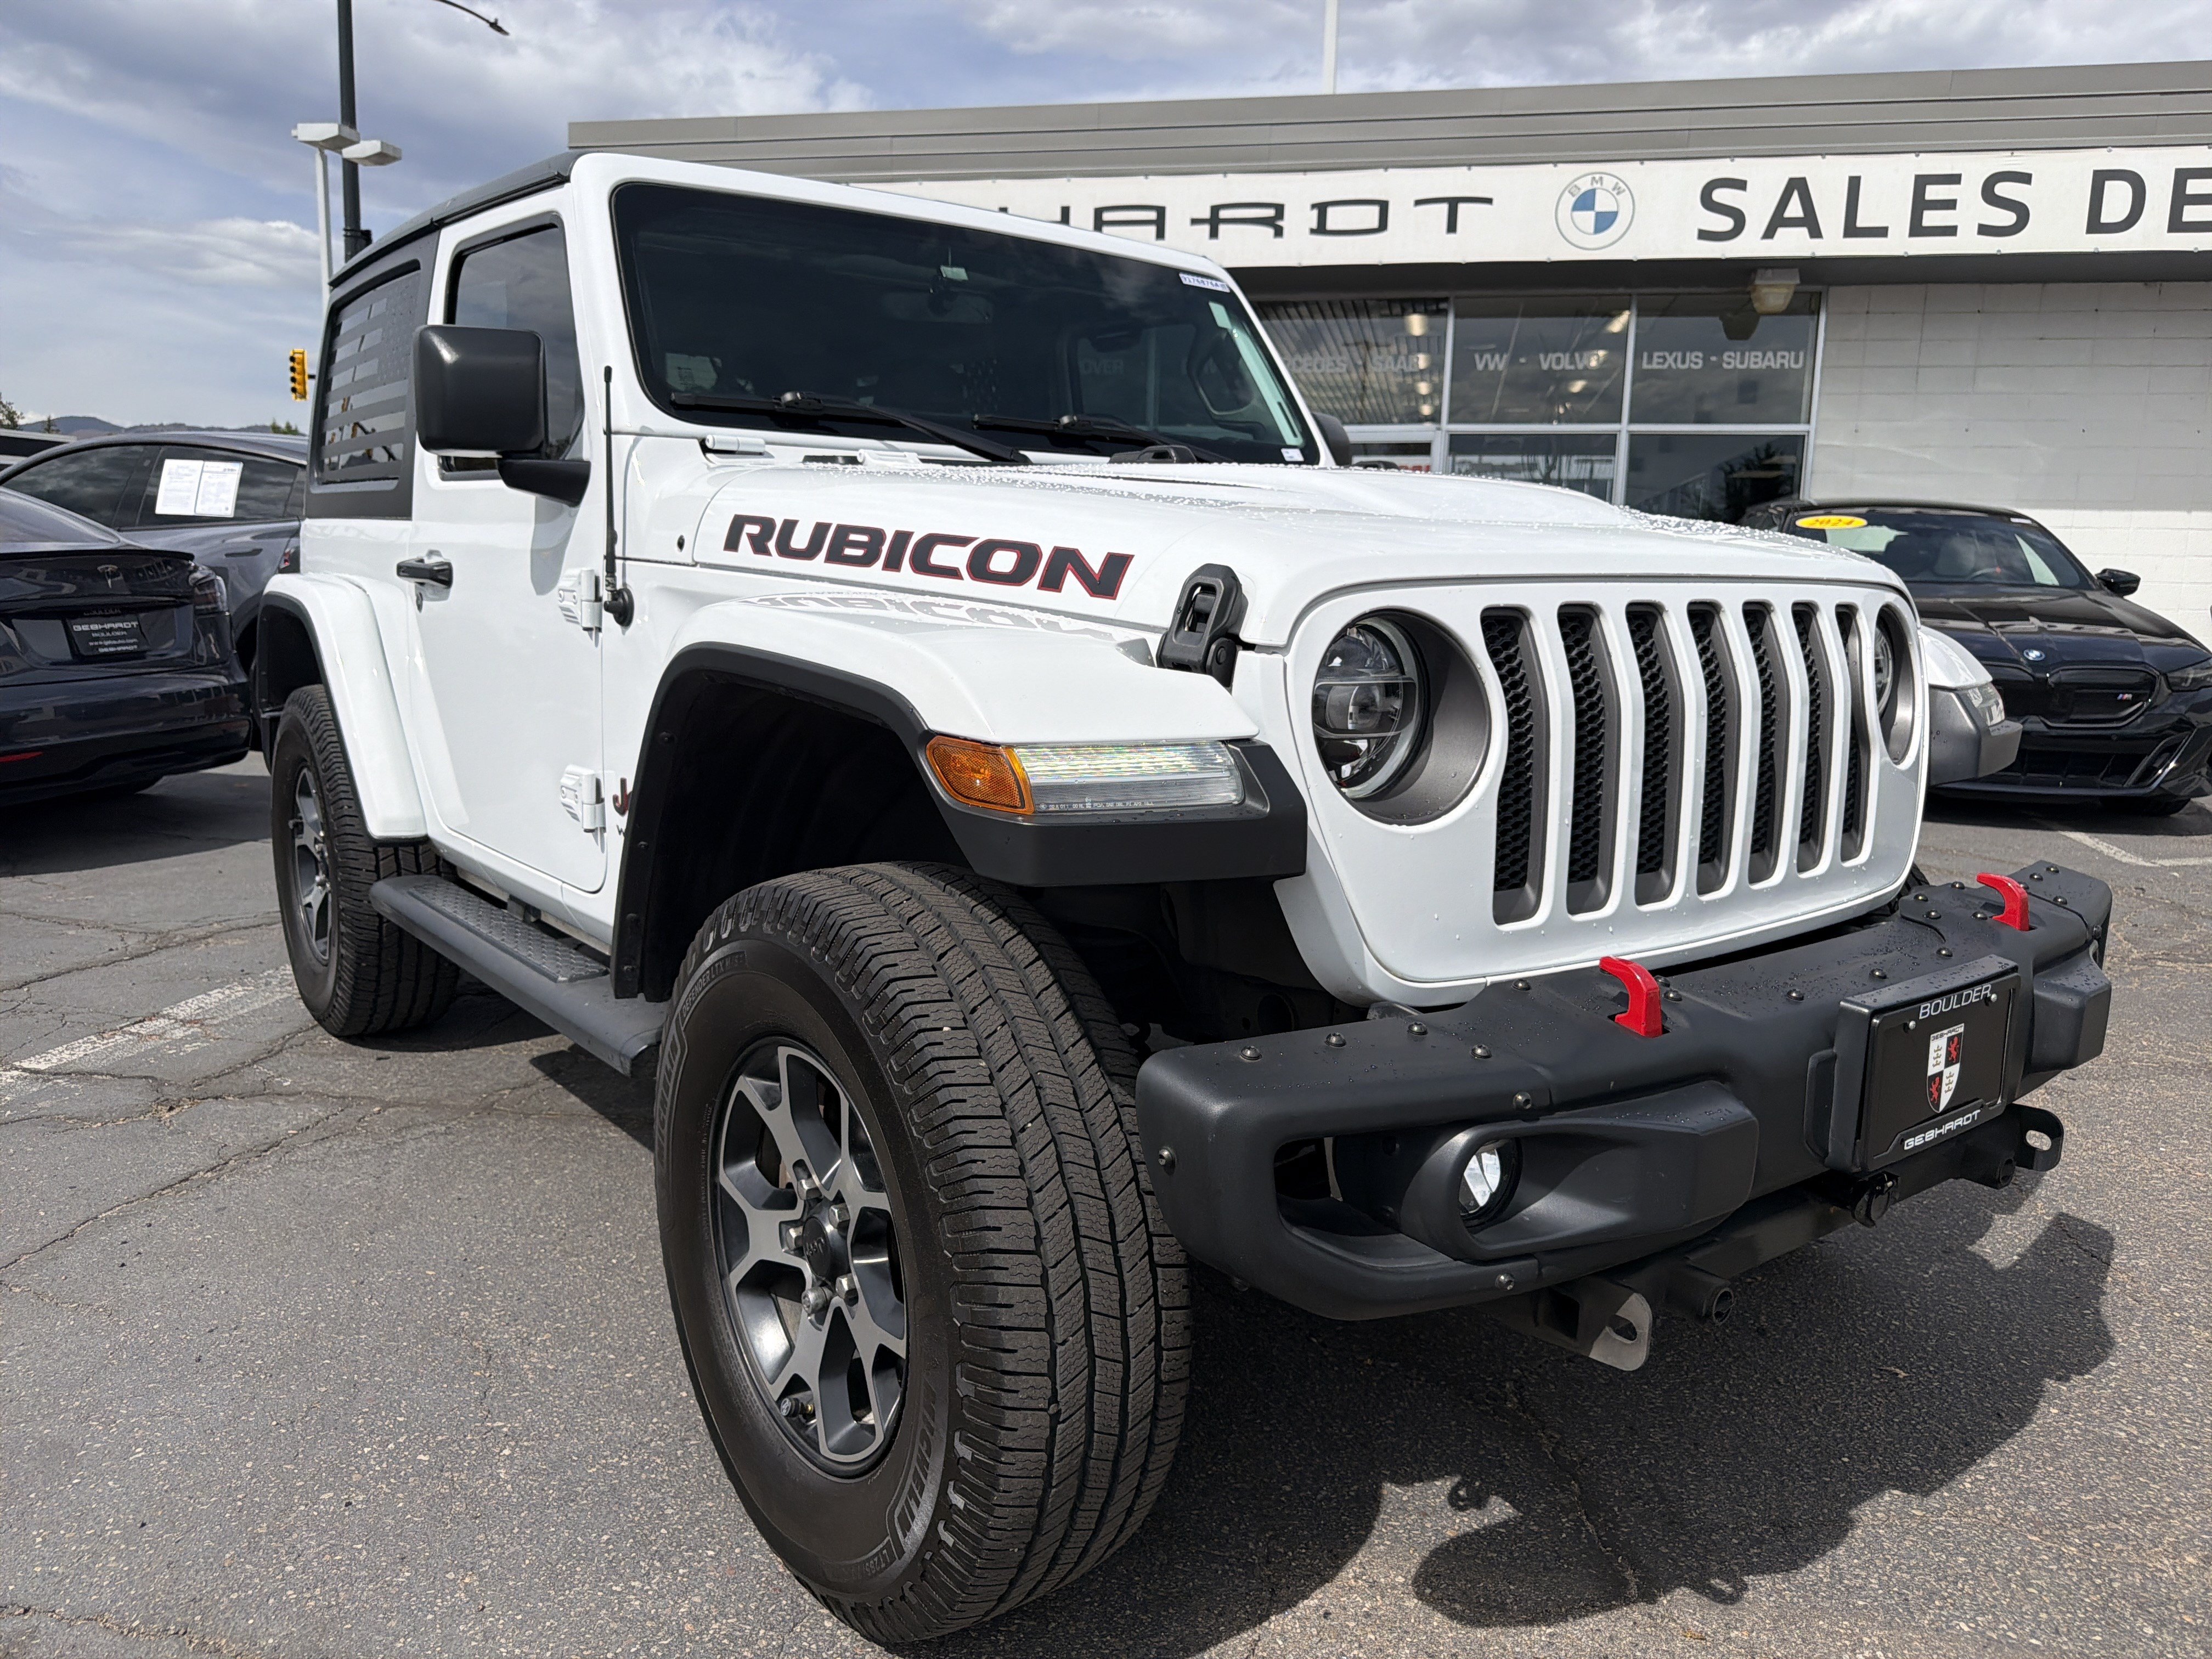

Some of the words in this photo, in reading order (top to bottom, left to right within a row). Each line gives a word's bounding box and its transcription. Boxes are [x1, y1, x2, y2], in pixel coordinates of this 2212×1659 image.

[1567, 176, 1626, 198] BMW
[1697, 171, 2033, 242] SALES
[1474, 352, 1508, 371] VW
[1538, 351, 1600, 370] VOLVO
[1641, 351, 1703, 369] LEXUS
[1722, 350, 1805, 370] SUBARU
[1808, 518, 1854, 527] 2024
[724, 514, 1135, 600] RUBICON
[72, 620, 139, 631] GEBHARDT
[682, 969, 711, 1018] DEFENDER
[1919, 984, 1992, 1020] BOULDER
[1931, 1025, 1963, 1042] GEBHARDT
[1904, 1109, 1981, 1150] GEBHARDT
[896, 1376, 936, 1541] MICHELIN
